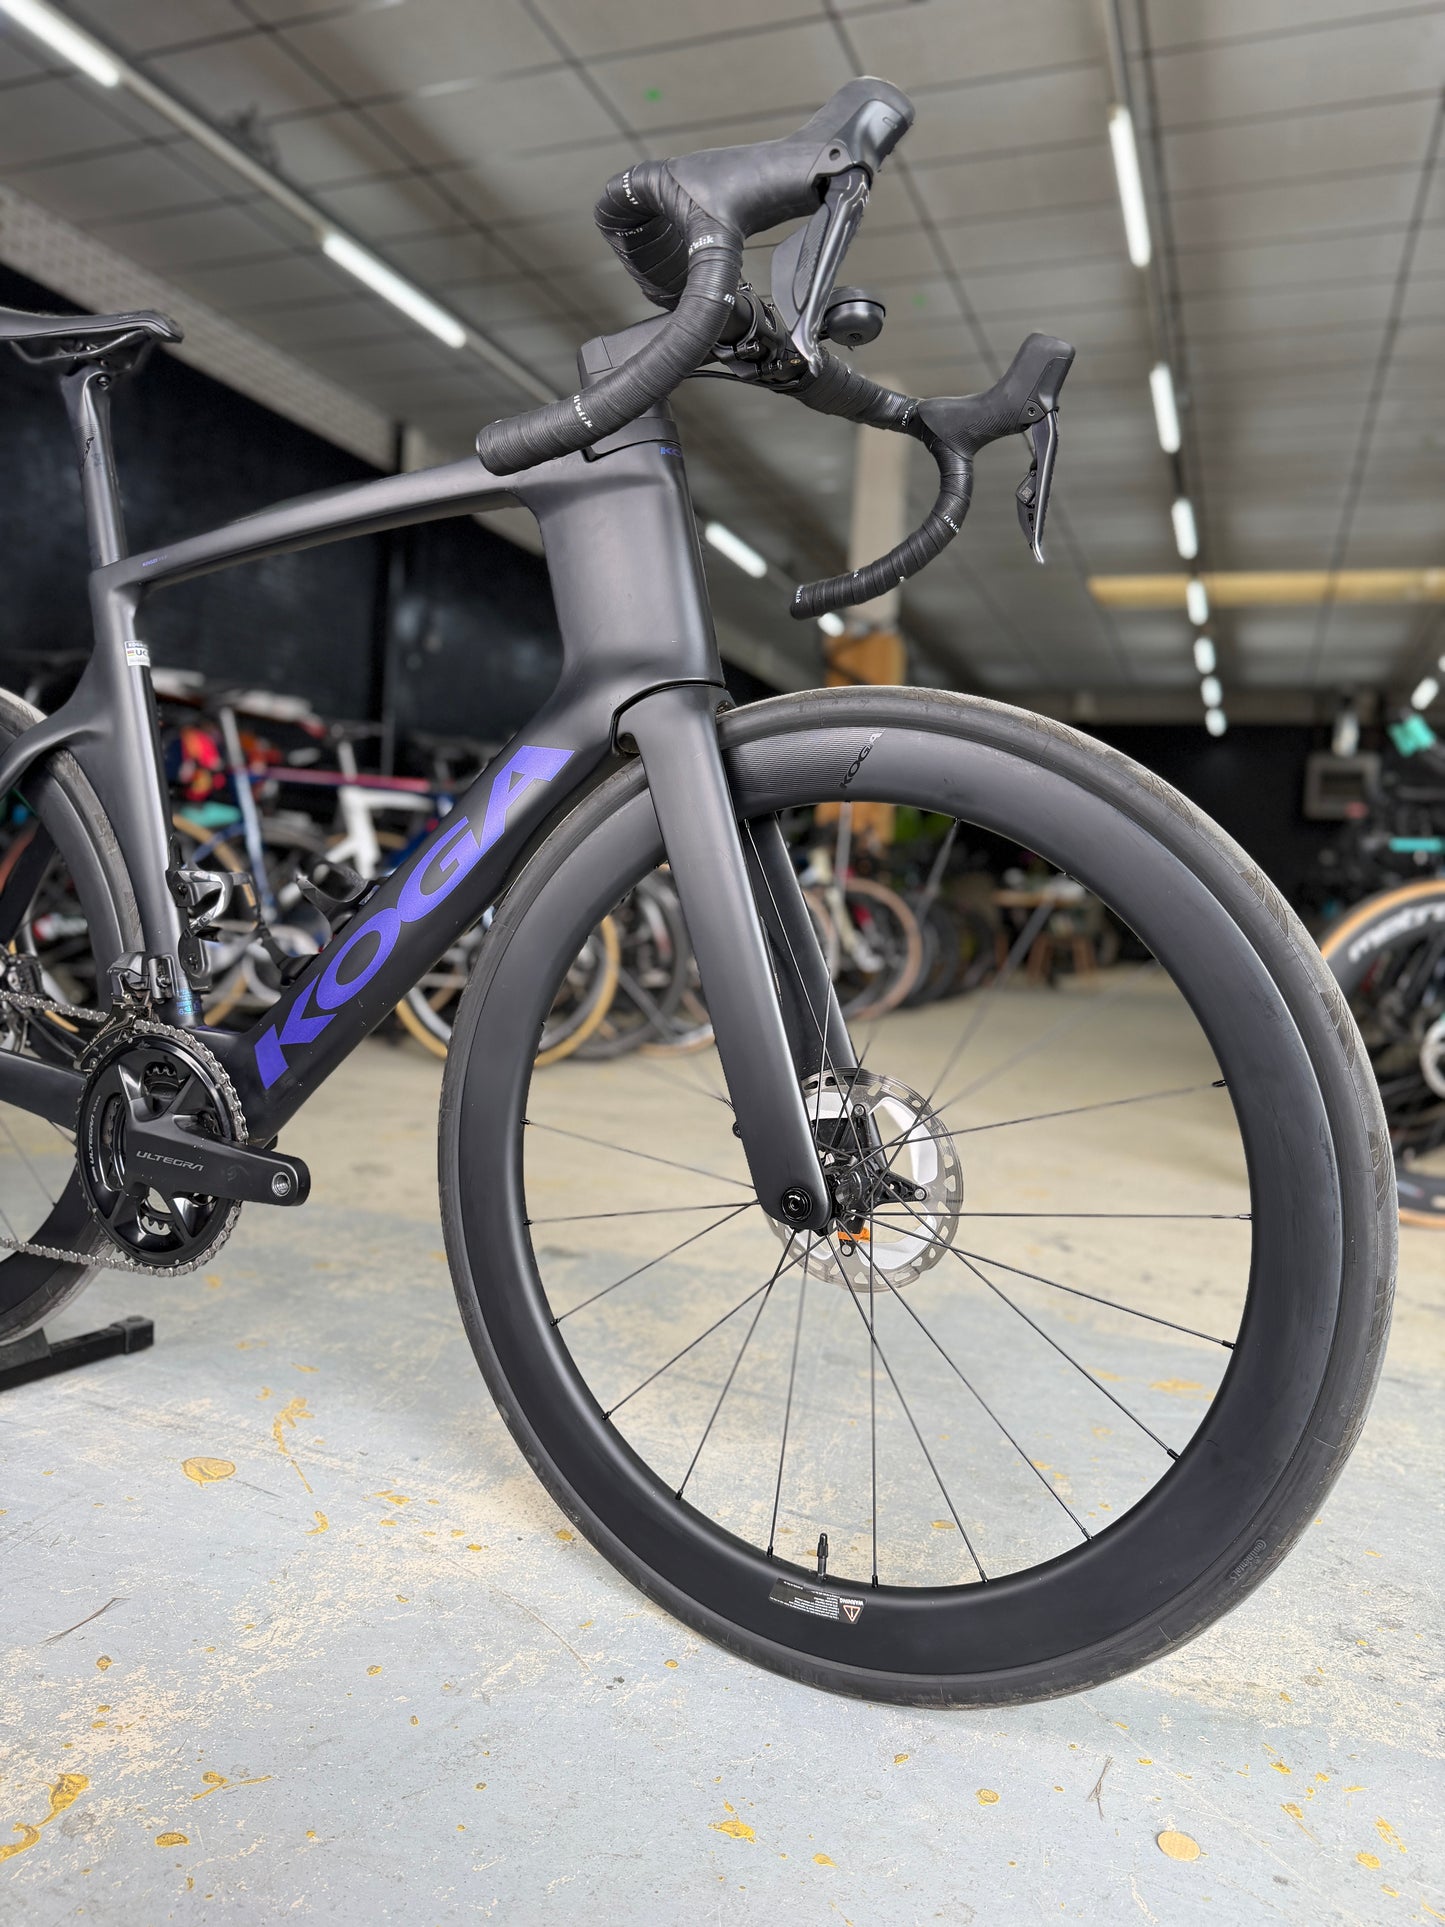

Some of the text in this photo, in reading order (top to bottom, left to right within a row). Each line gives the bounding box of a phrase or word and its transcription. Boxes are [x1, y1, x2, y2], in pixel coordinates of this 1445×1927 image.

[839, 728, 887, 790] KOGA
[254, 744, 576, 1090] KOGA
[87, 1113, 96, 1165] ULTEGRA
[135, 1150, 205, 1172] ULTEGRA
[1232, 1538, 1267, 1578] Continental
